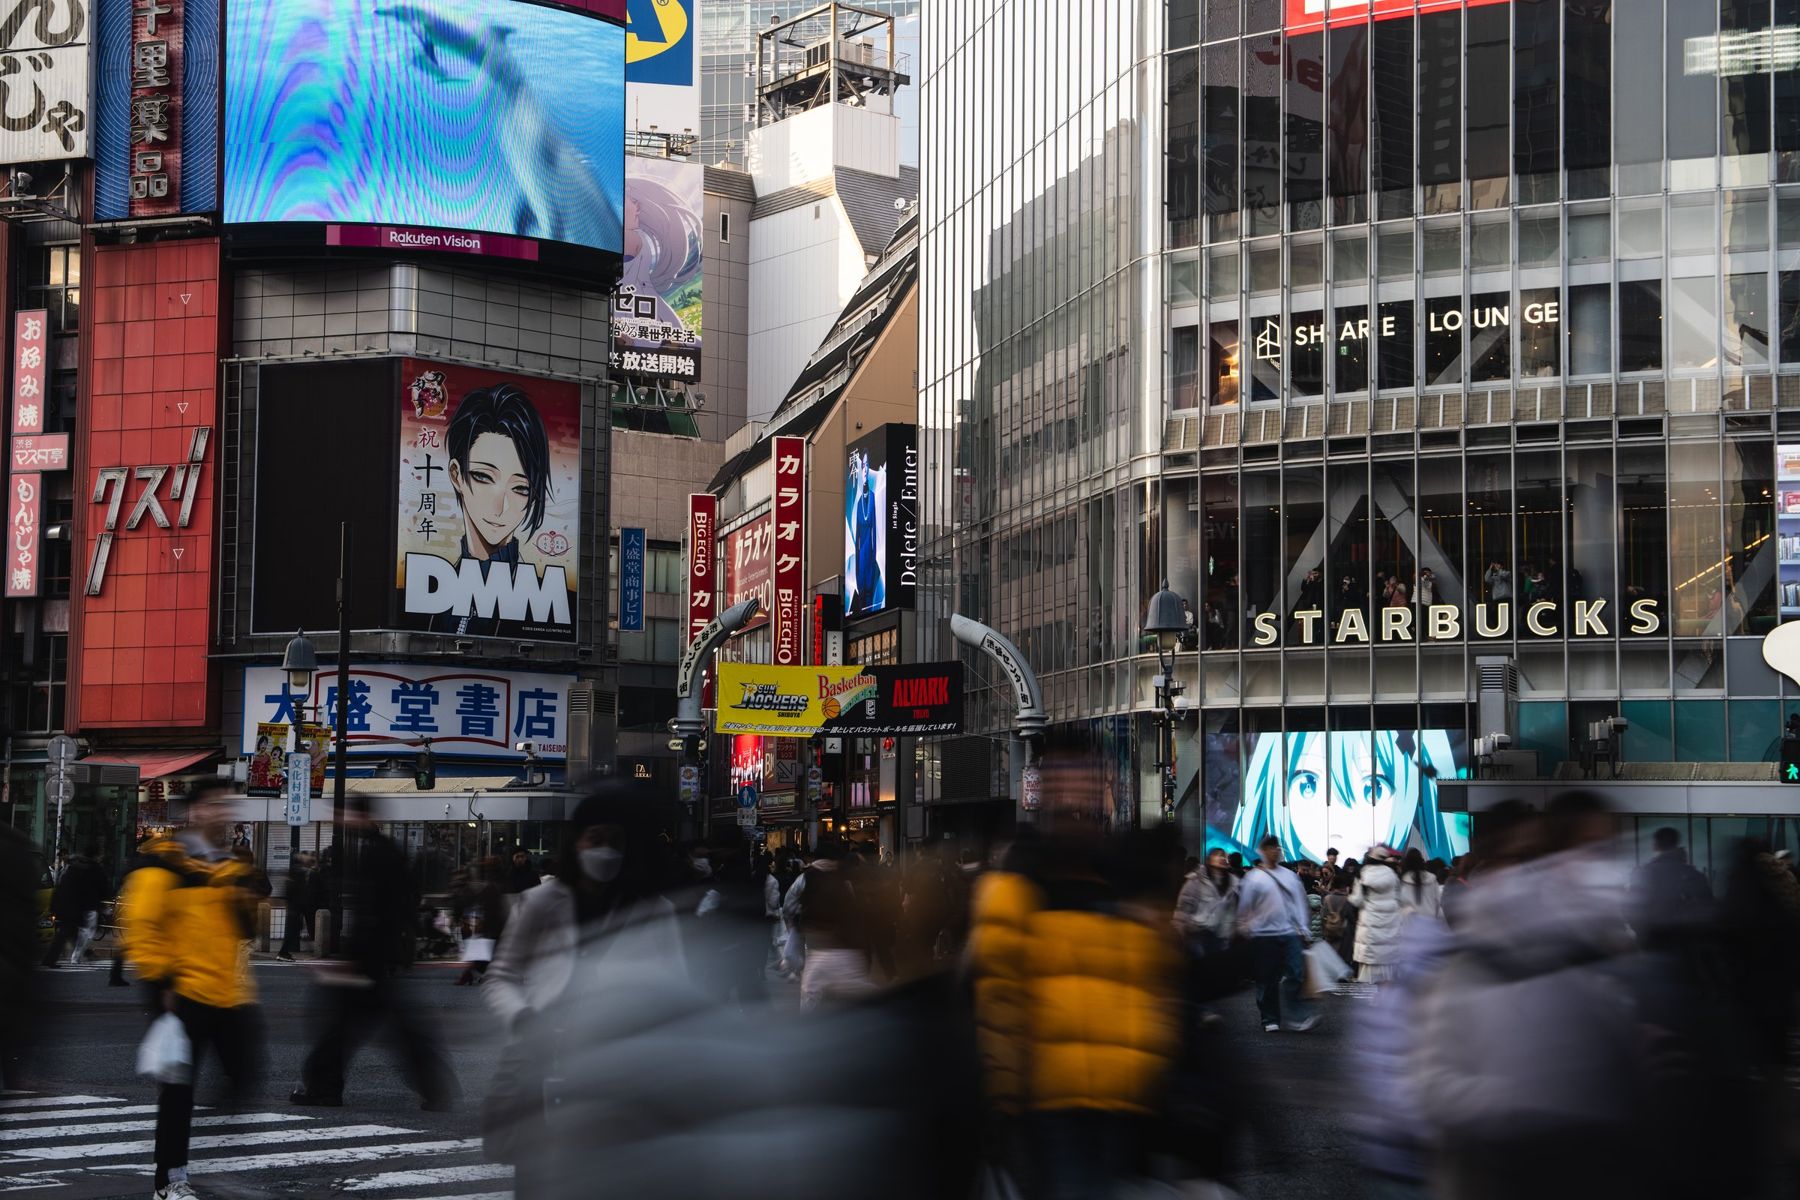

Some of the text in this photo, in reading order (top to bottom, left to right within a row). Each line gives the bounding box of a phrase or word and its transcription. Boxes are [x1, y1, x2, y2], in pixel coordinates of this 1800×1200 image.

[390, 231, 481, 248] Rakuten Vision
[1295, 302, 1559, 346] SHARE LOUNGE
[18, 318, 41, 428] お好み焼
[623, 352, 695, 375] 放送開始
[414, 427, 443, 542] 祝 十周年
[777, 455, 801, 573] カラオケ
[12, 480, 34, 591] もんじゃ焼
[694, 512, 707, 577] BIG ECHO
[735, 521, 772, 570] カラオケ
[405, 552, 571, 625] DMM
[626, 534, 640, 625] 大盛堂商事ビル
[778, 589, 792, 664] BIG ECHO
[1254, 598, 1660, 646] STARBUCKS
[679, 622, 718, 695] 渋谷センター街
[818, 674, 877, 699] Basketball
[986, 638, 1029, 705] 渋谷センター街
[264, 680, 558, 739] 大盛堂書店
[730, 682, 808, 711] ROCKERS
[758, 684, 776, 693] SUN
[892, 677, 949, 708] ALVARK
[291, 759, 302, 814] 文化村通り
